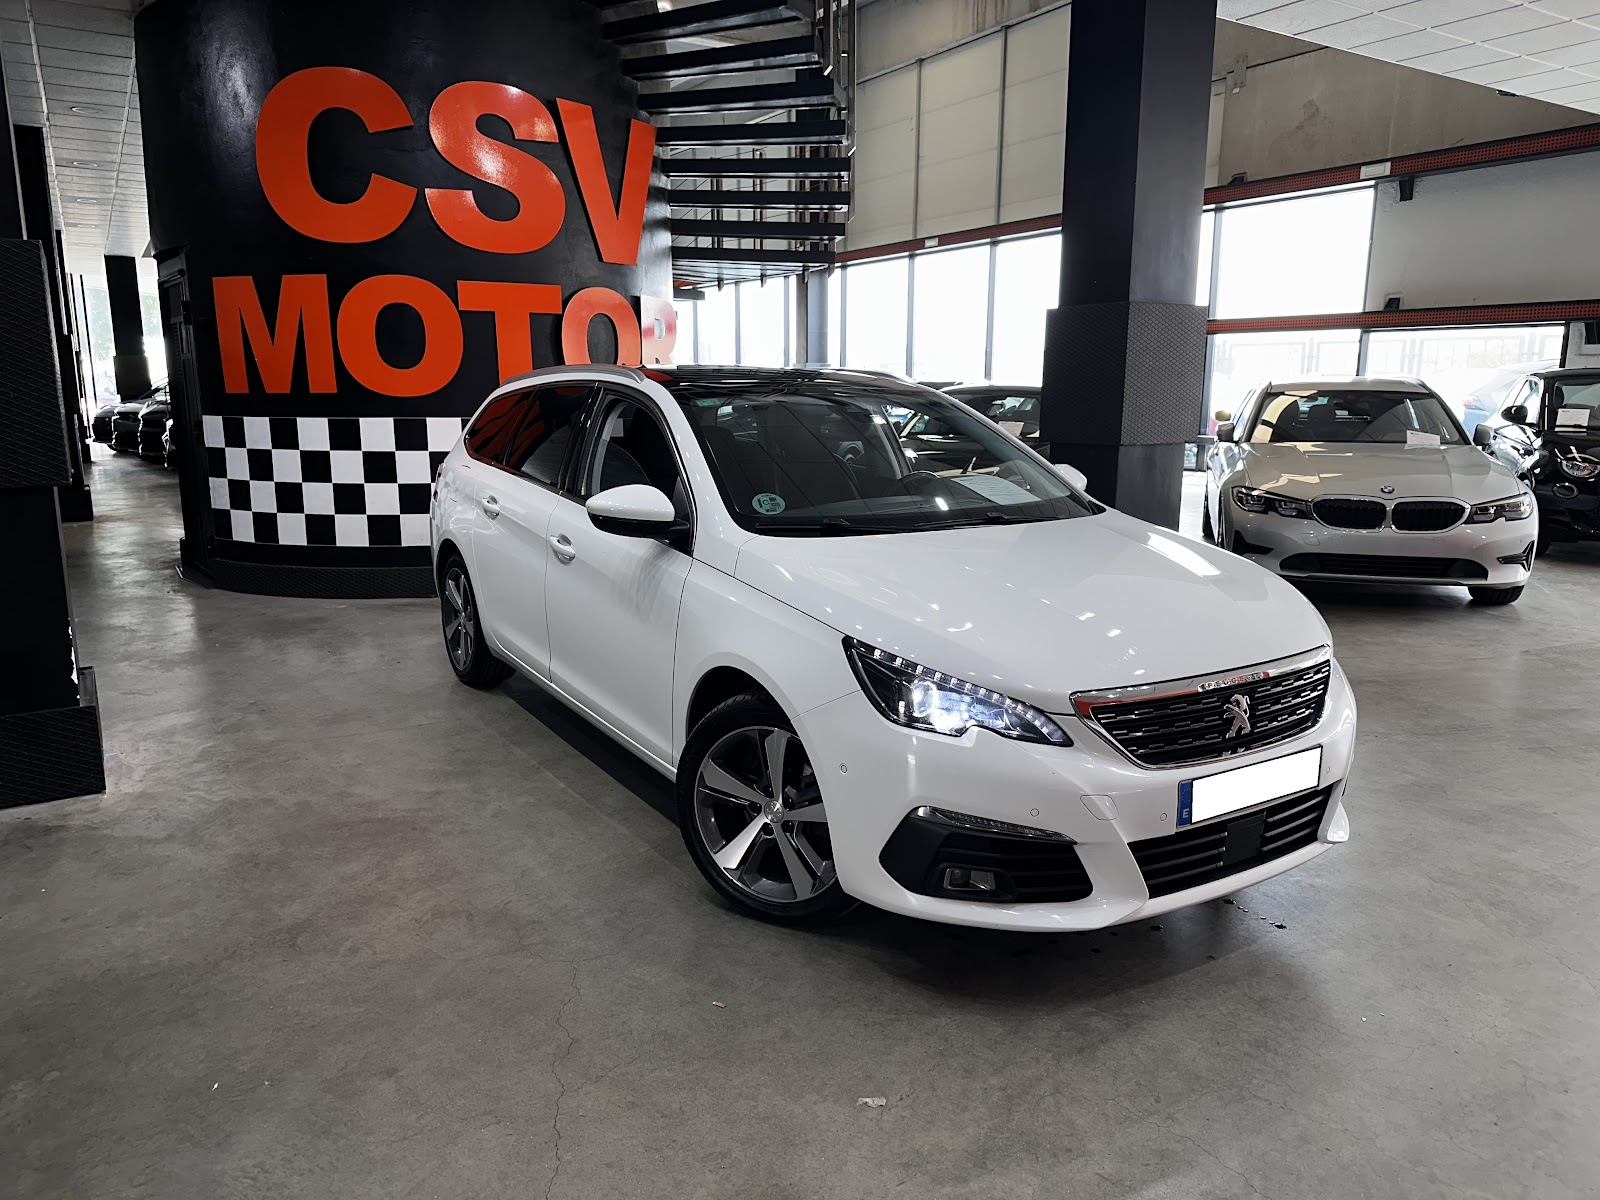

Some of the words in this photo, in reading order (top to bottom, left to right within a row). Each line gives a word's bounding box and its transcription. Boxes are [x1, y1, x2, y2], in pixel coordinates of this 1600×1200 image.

[256, 66, 656, 265] CSV
[212, 274, 677, 396] MOTOR
[1182, 808, 1190, 819] E
